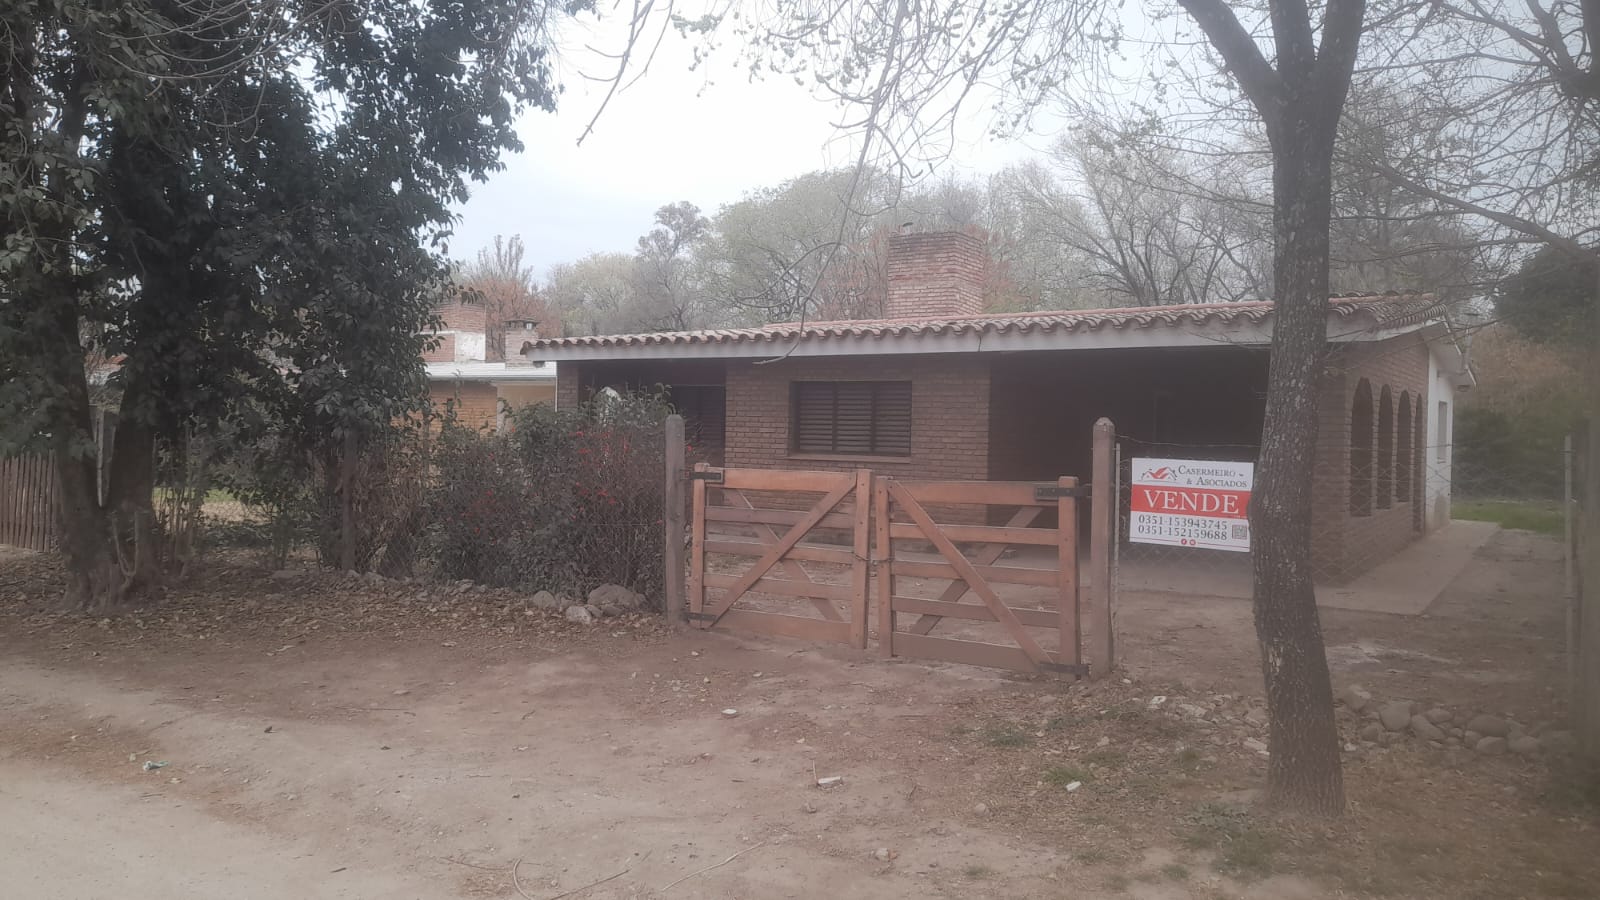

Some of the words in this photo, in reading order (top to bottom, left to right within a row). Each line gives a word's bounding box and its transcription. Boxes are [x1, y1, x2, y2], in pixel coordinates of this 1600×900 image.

[1178, 465, 1236, 478] CASERMEIRO
[1196, 477, 1248, 488] ASOCIADOS
[1144, 489, 1239, 514] VENDE
[1138, 514, 1228, 531] 0351-153943745
[1138, 525, 1228, 541] 0351-152159688
